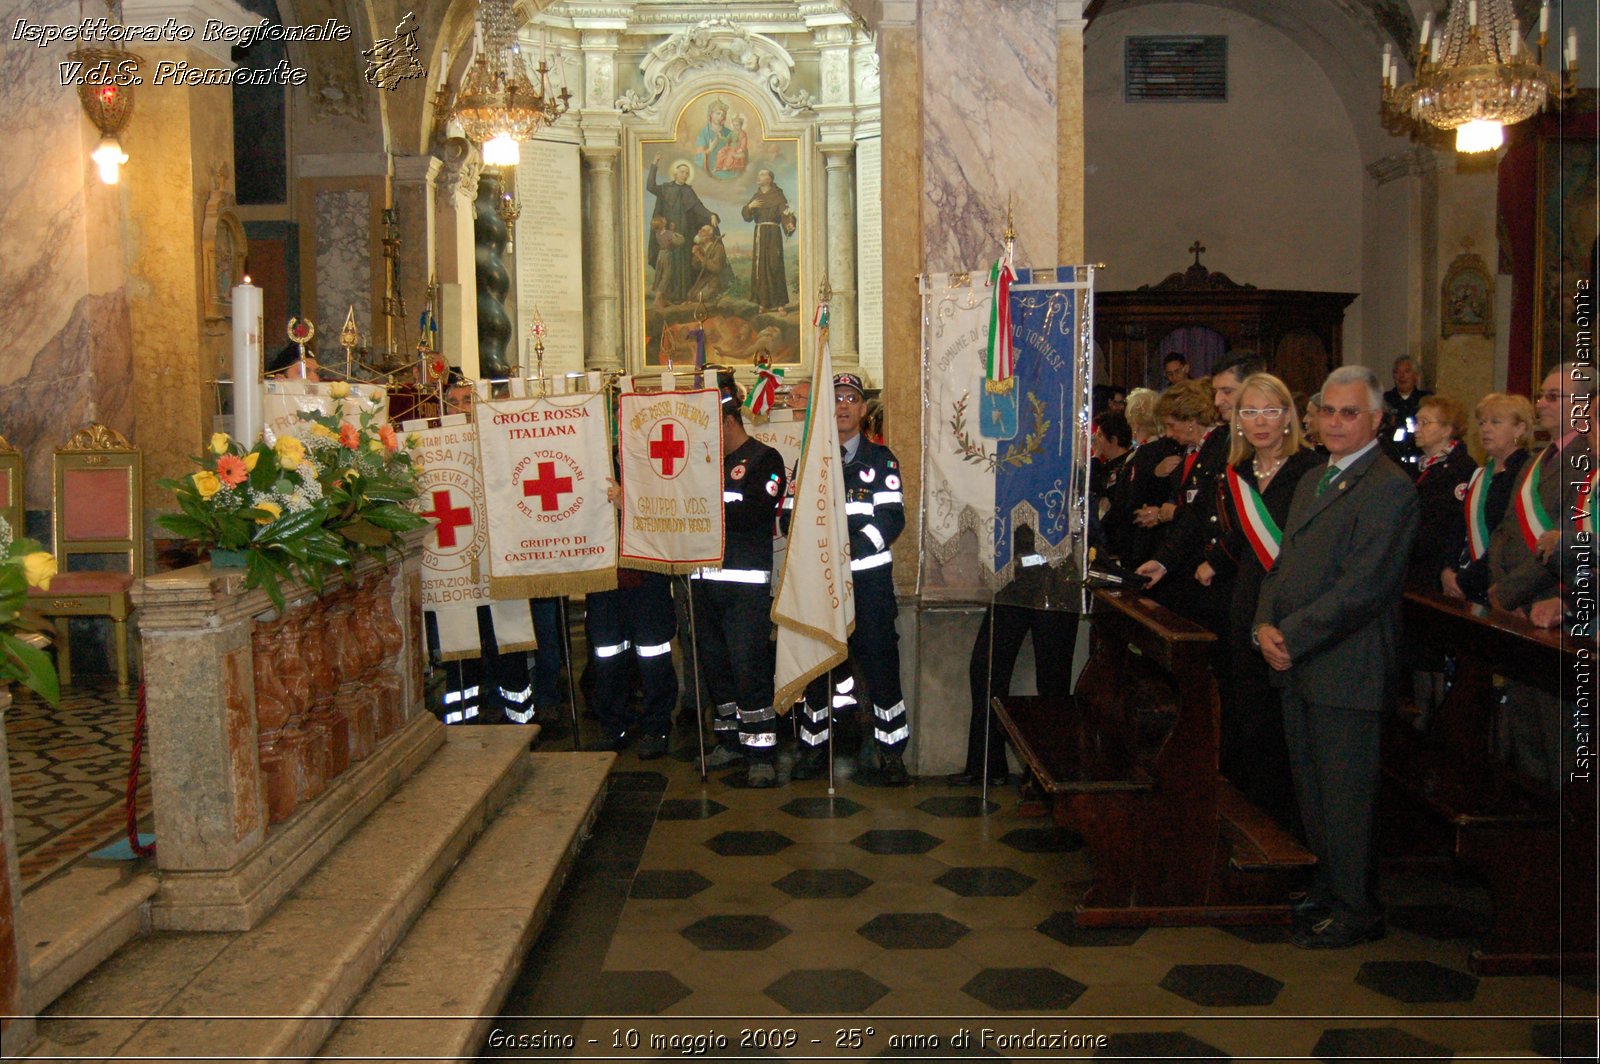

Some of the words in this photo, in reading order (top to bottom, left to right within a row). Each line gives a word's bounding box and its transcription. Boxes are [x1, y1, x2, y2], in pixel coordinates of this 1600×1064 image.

[938, 334, 969, 372] COMUNE
[970, 327, 979, 341] DI
[1026, 328, 1065, 372] TORINESE
[493, 411, 540, 425] CROCE
[543, 406, 590, 420] ROSSA
[445, 433, 460, 444] DEL
[509, 425, 576, 439] ITALIANA
[755, 432, 777, 443] SSA
[512, 456, 532, 486] CORPO
[534, 450, 585, 482] VOLONTARI
[816, 454, 833, 526] ROSSA
[517, 501, 532, 519] DEL
[536, 496, 585, 523] SOCCORSO
[637, 496, 677, 516] GRUPPO
[520, 536, 570, 549] GRUPPO
[574, 535, 587, 545] DI
[818, 537, 840, 609] CROCE
